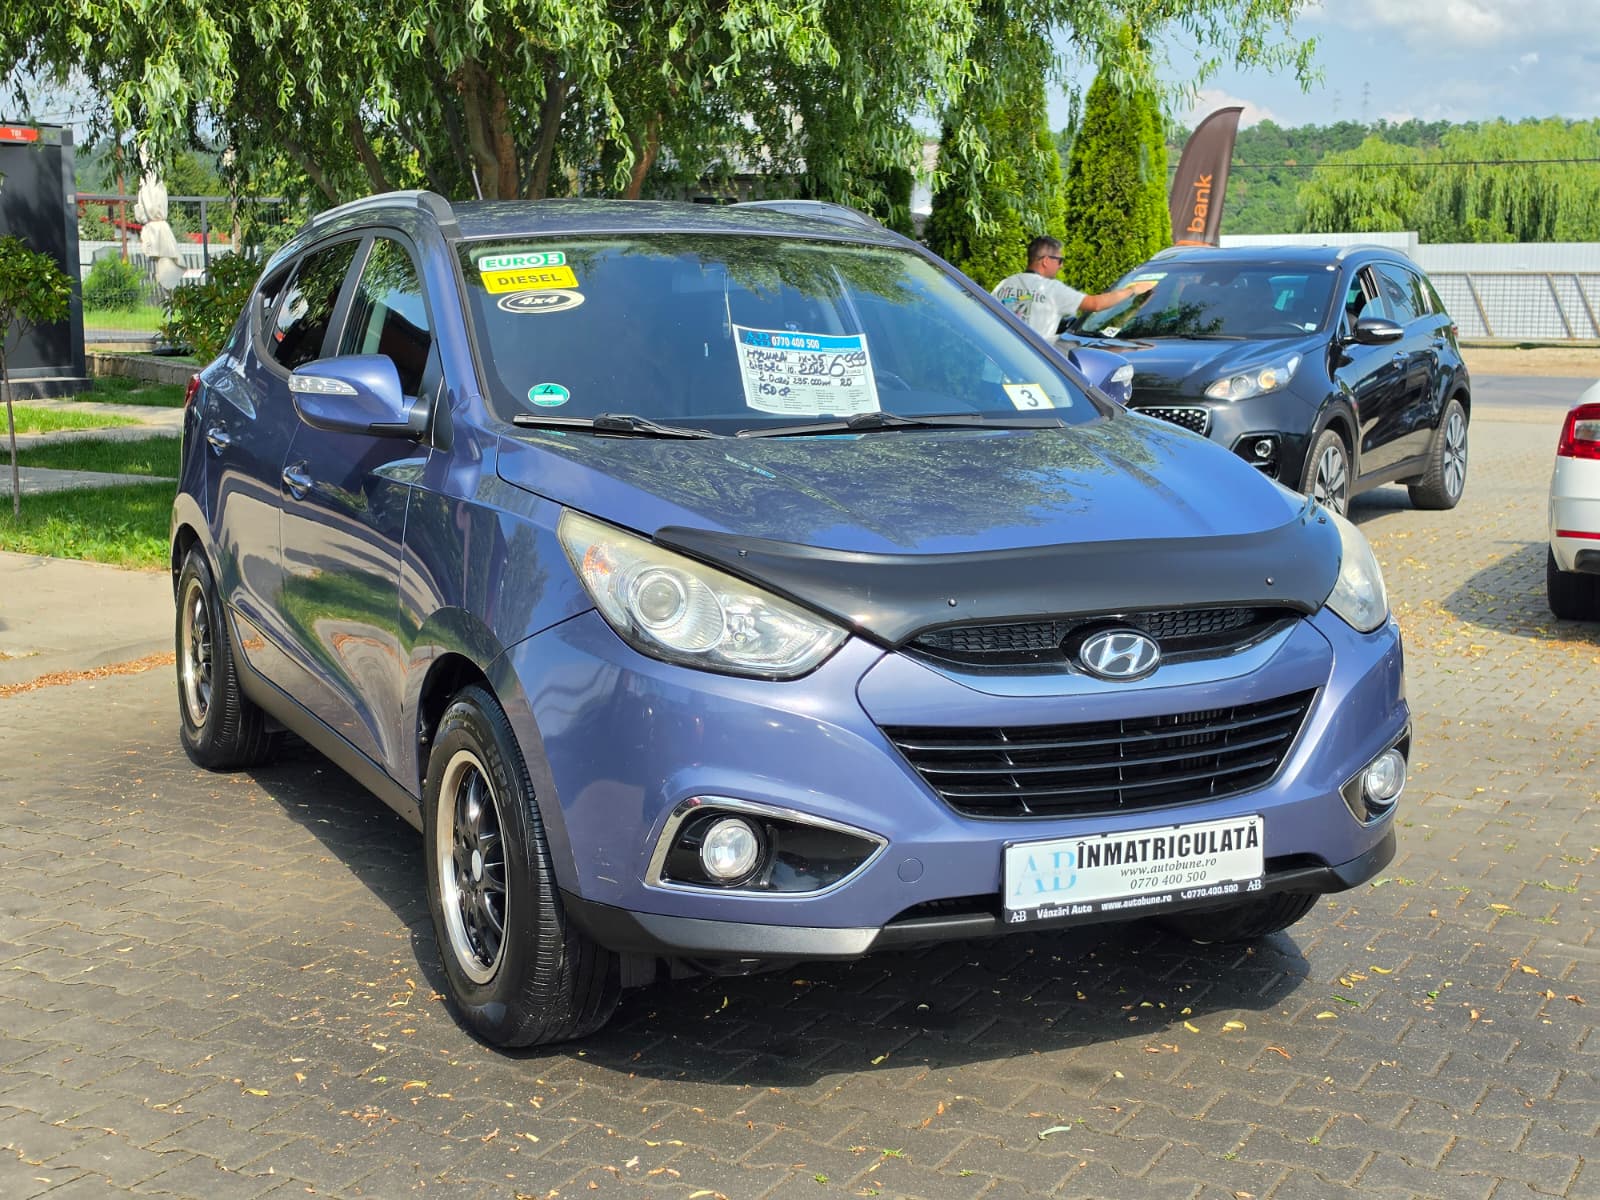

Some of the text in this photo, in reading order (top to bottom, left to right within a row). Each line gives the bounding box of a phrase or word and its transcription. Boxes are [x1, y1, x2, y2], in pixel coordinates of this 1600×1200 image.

[1186, 174, 1213, 233] bank
[484, 252, 560, 269] EURO 5
[497, 273, 562, 287] DIESEL
[518, 295, 560, 306] 4x4
[771, 336, 790, 347] 0770
[806, 338, 820, 350] 500
[1020, 389, 1039, 407] 3
[1076, 820, 1259, 870] ÎNMATRICULATĂ
[1120, 857, 1217, 878] www.autobune.ro
[1130, 870, 1207, 891] 0770 400 500
[1070, 904, 1093, 916] Auto
[1100, 894, 1173, 912] www.autobune.ro
[1186, 883, 1239, 899] 0770.400.500
